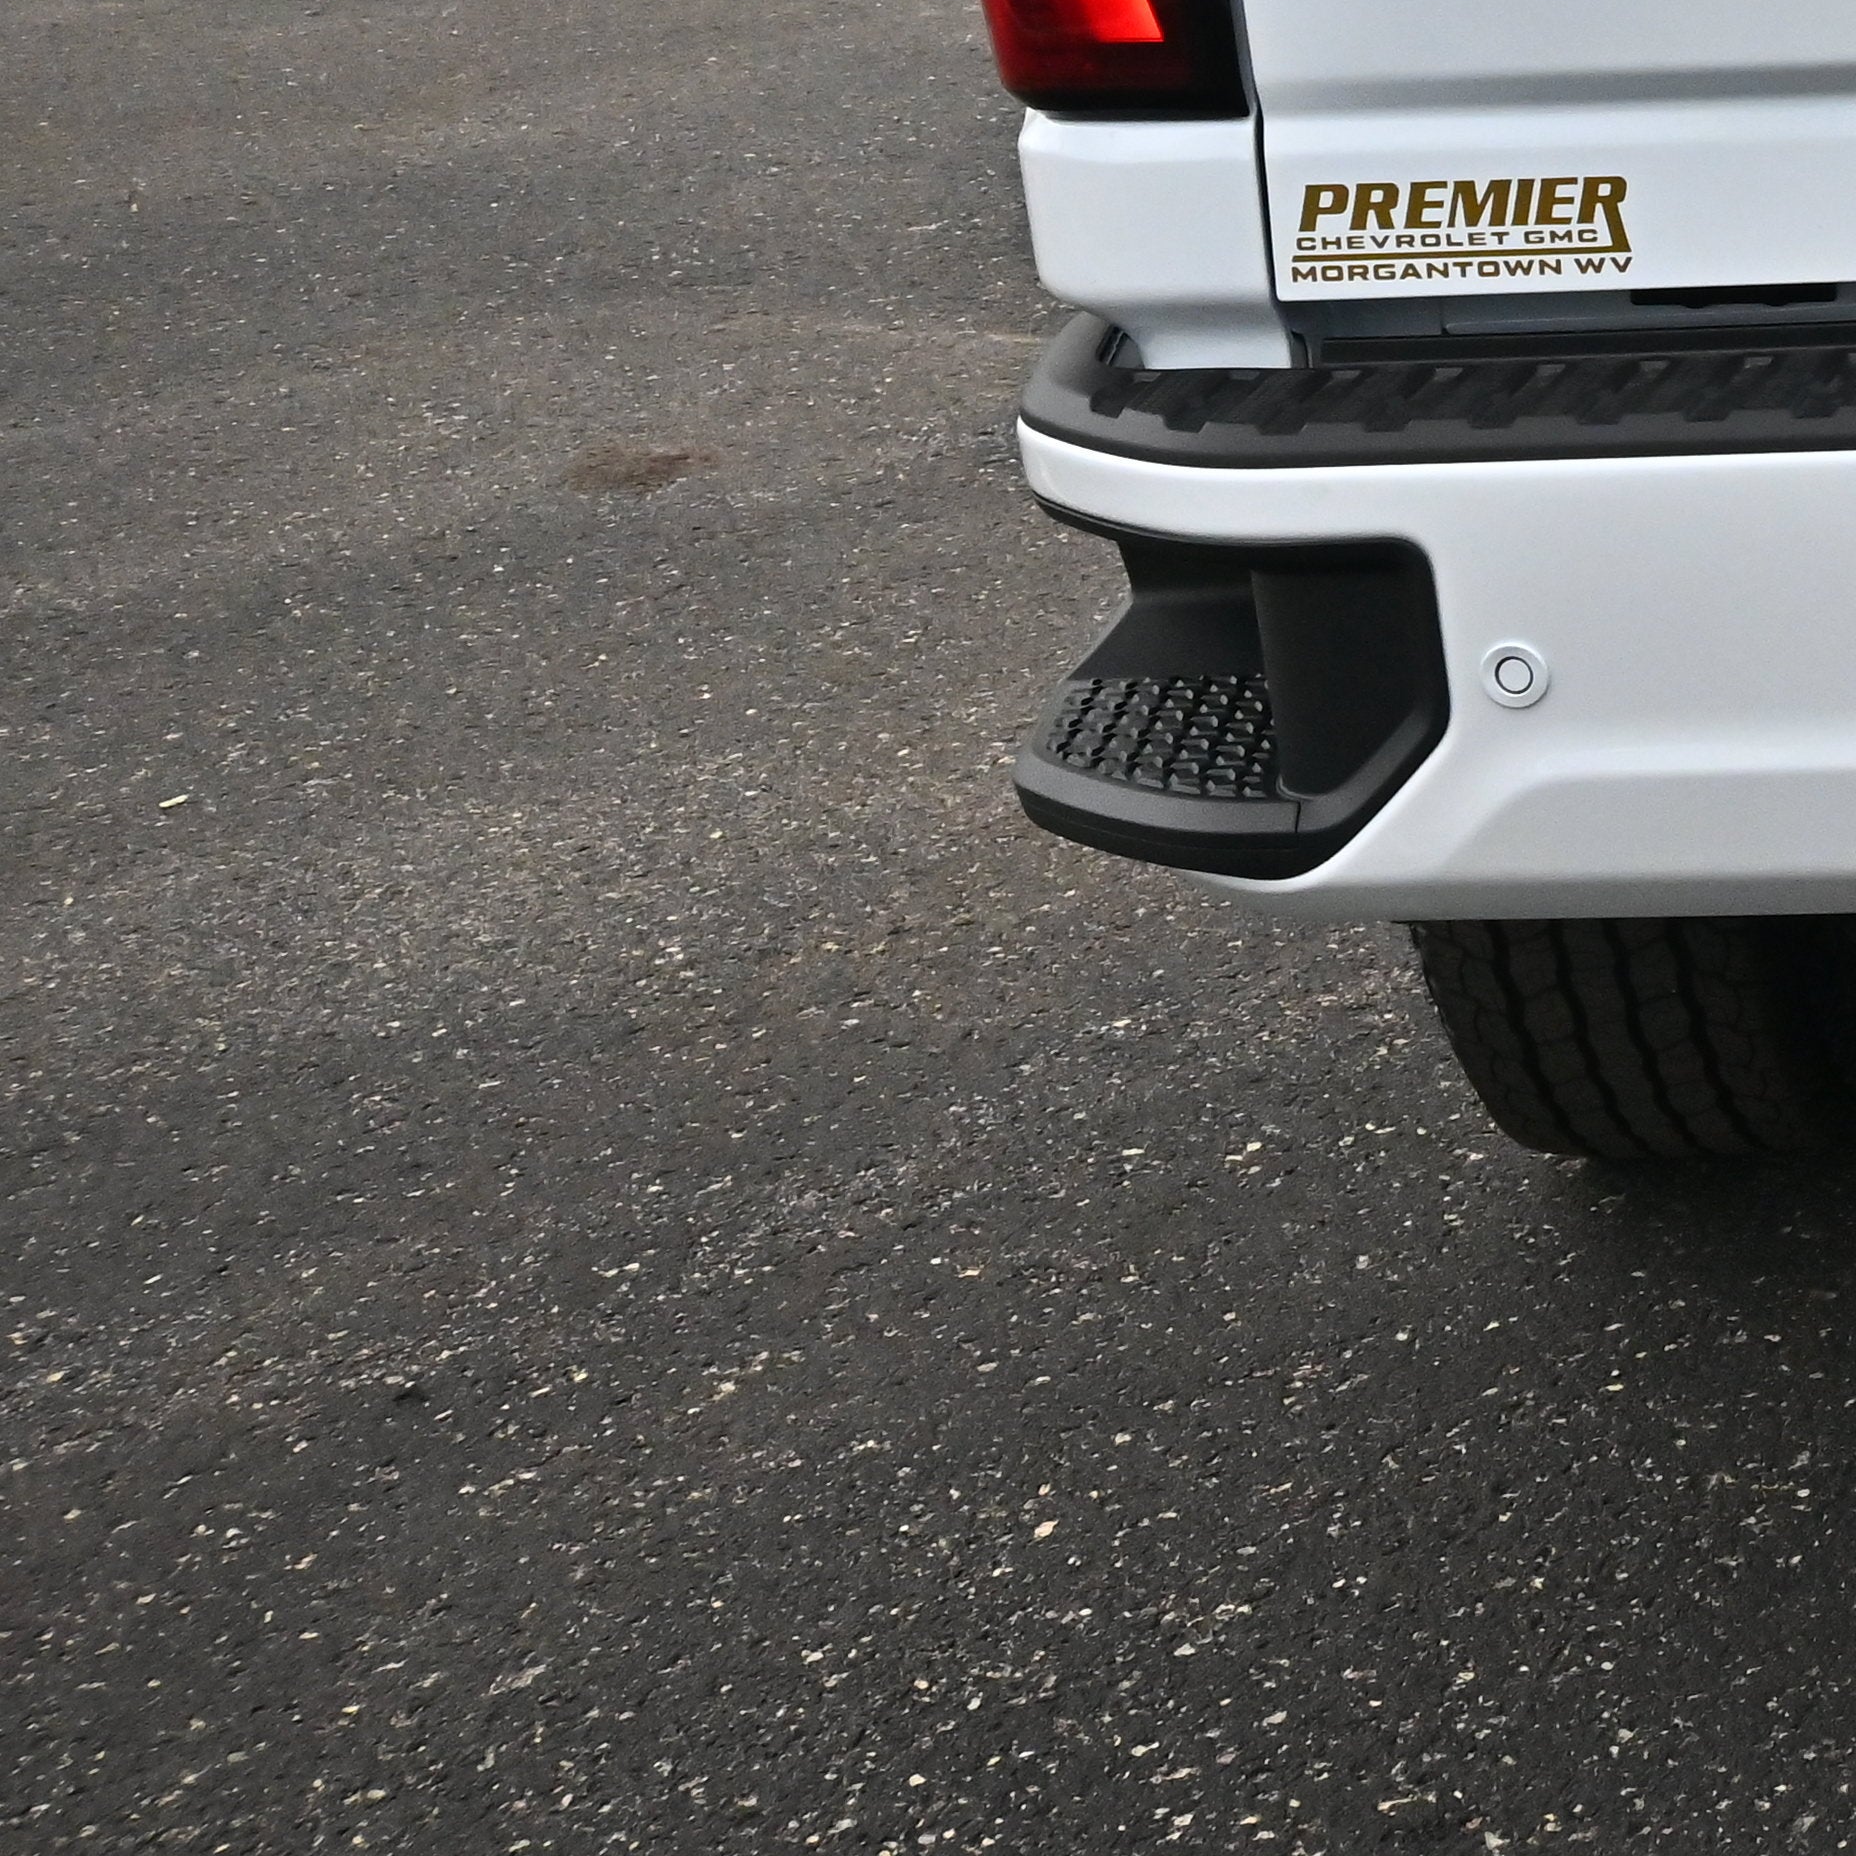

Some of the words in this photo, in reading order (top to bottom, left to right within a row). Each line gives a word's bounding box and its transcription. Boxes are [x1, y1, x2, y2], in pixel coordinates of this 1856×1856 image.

[1299, 176, 1632, 252] PREMIER
[1296, 231, 1510, 250] CHEVROLET
[1524, 228, 1598, 245] GMC
[1292, 258, 1563, 283] MORGANTOWN
[1574, 256, 1632, 274] WV
